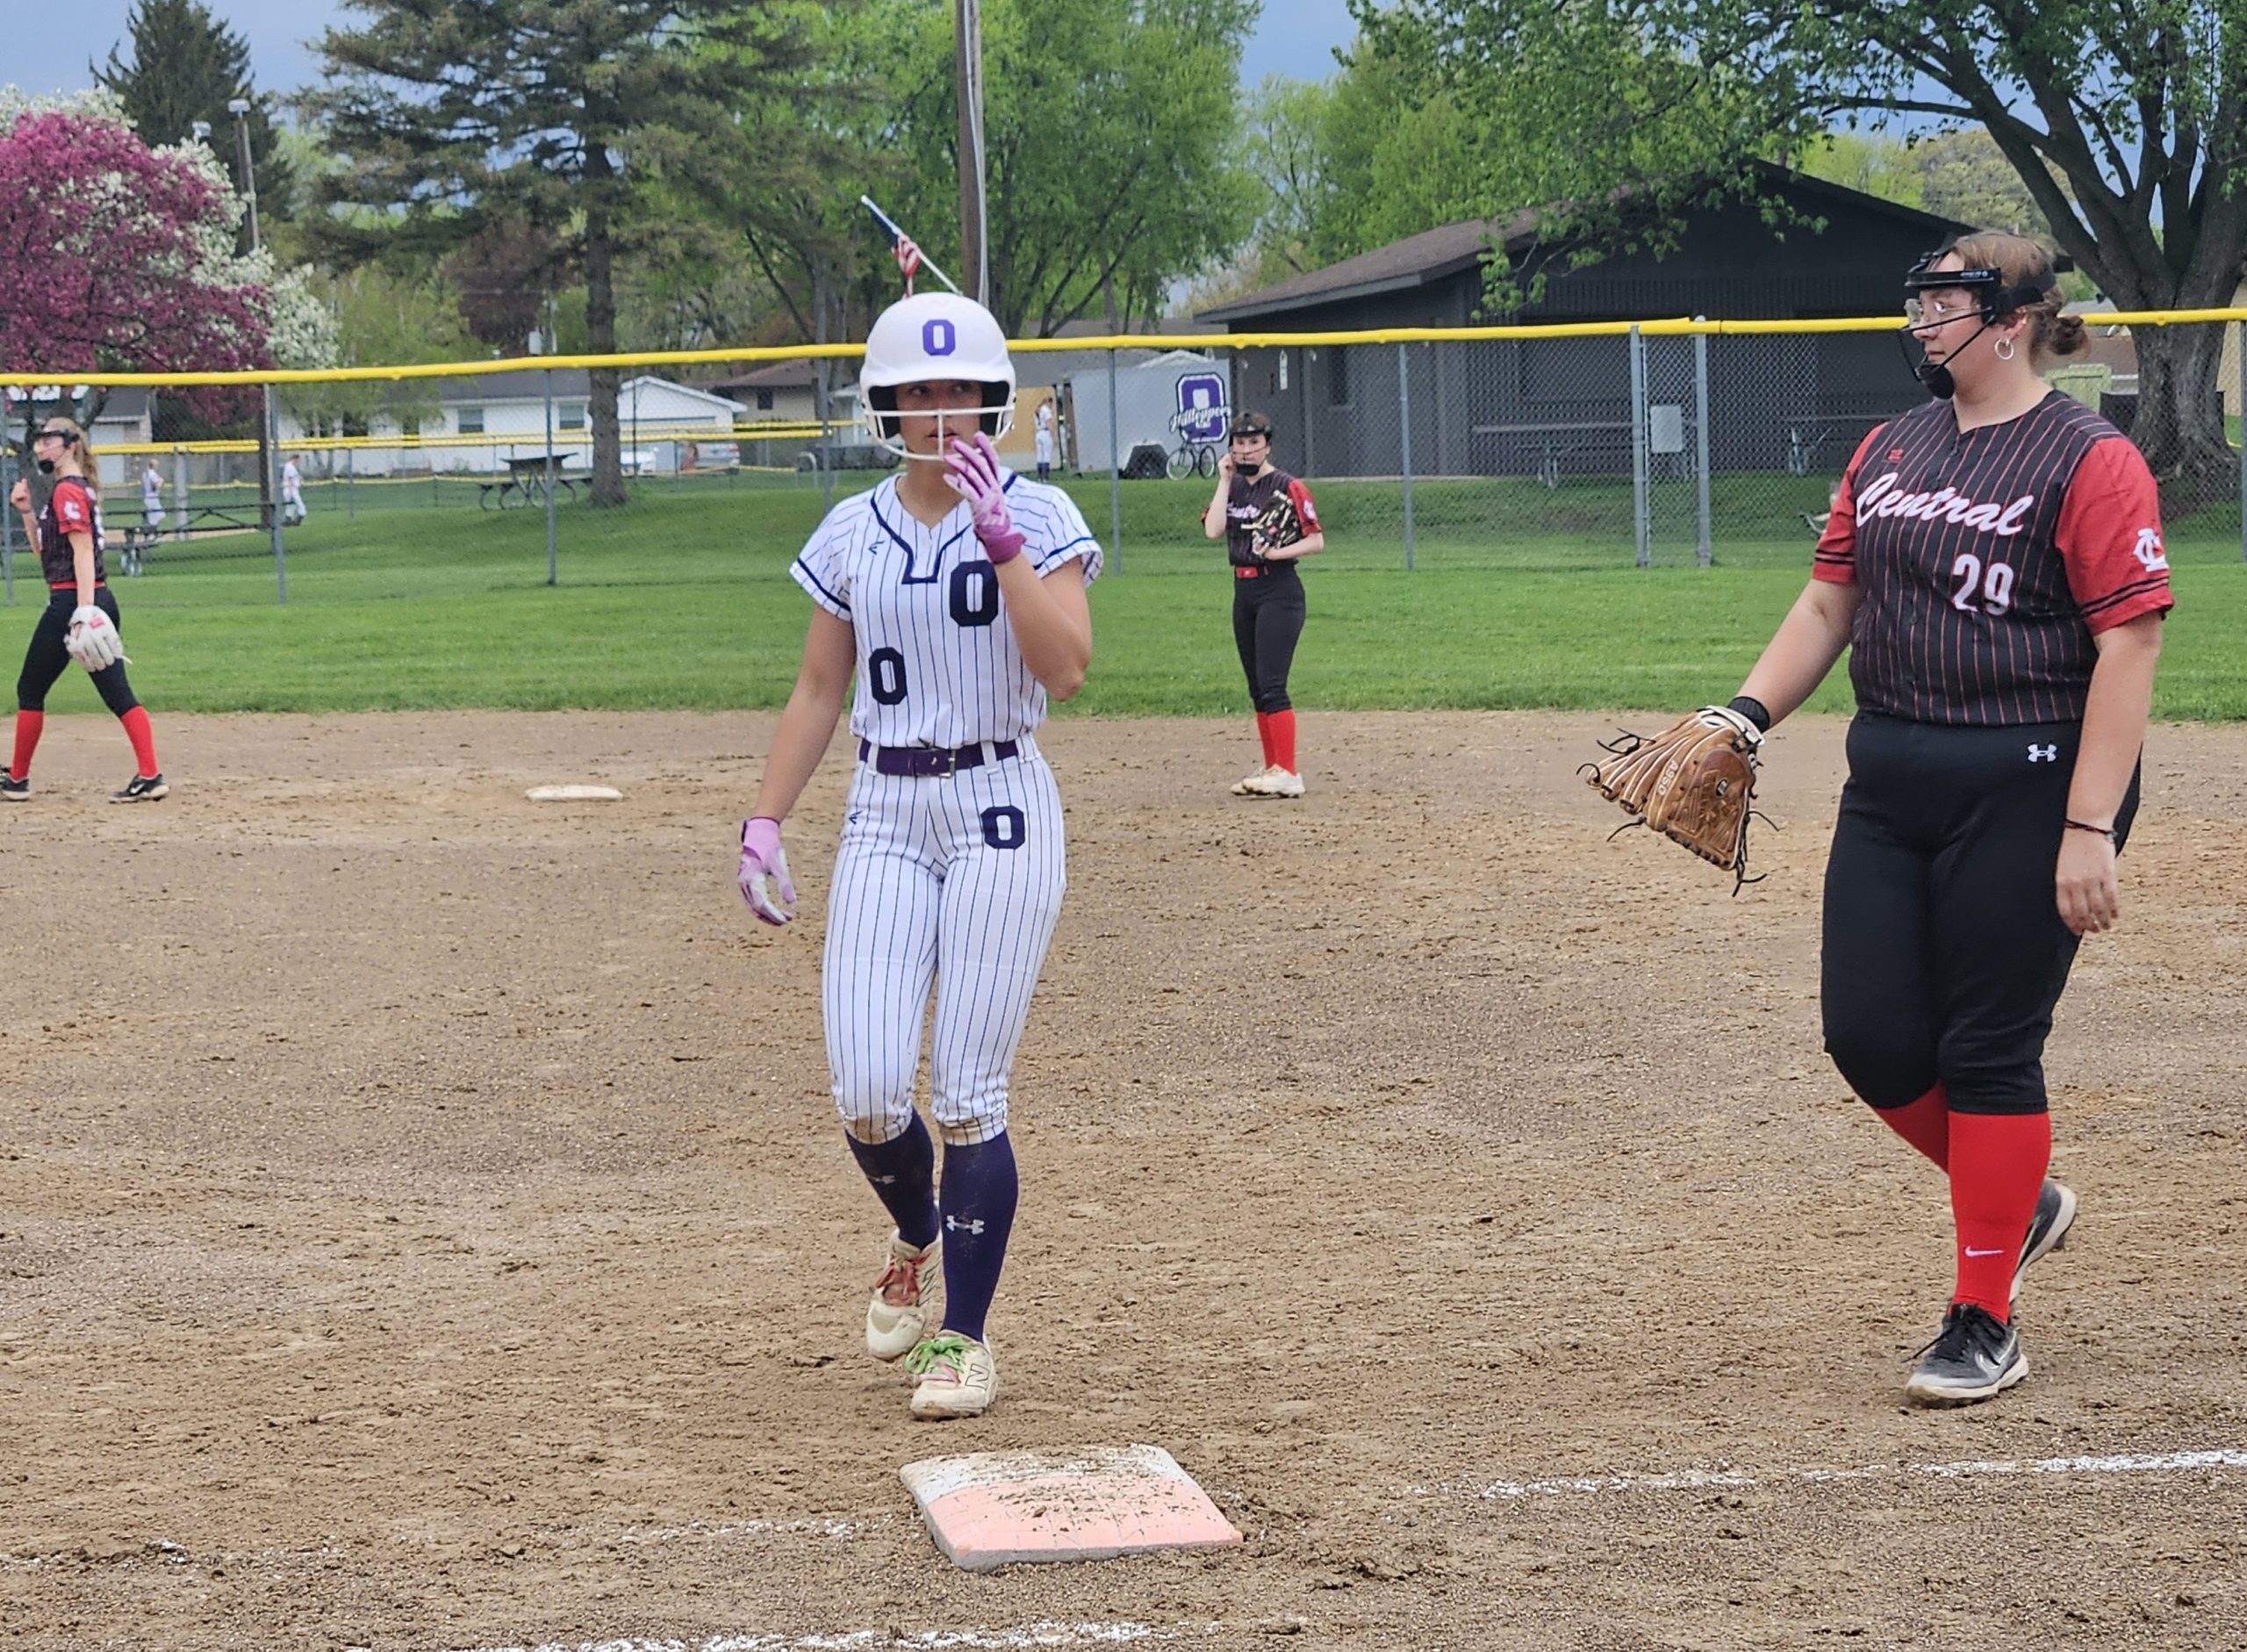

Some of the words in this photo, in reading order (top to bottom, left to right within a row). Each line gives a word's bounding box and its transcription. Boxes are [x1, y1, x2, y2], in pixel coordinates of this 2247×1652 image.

[922, 319, 956, 356] O
[1856, 471, 2034, 535] Central
[1951, 553, 2014, 616] 29
